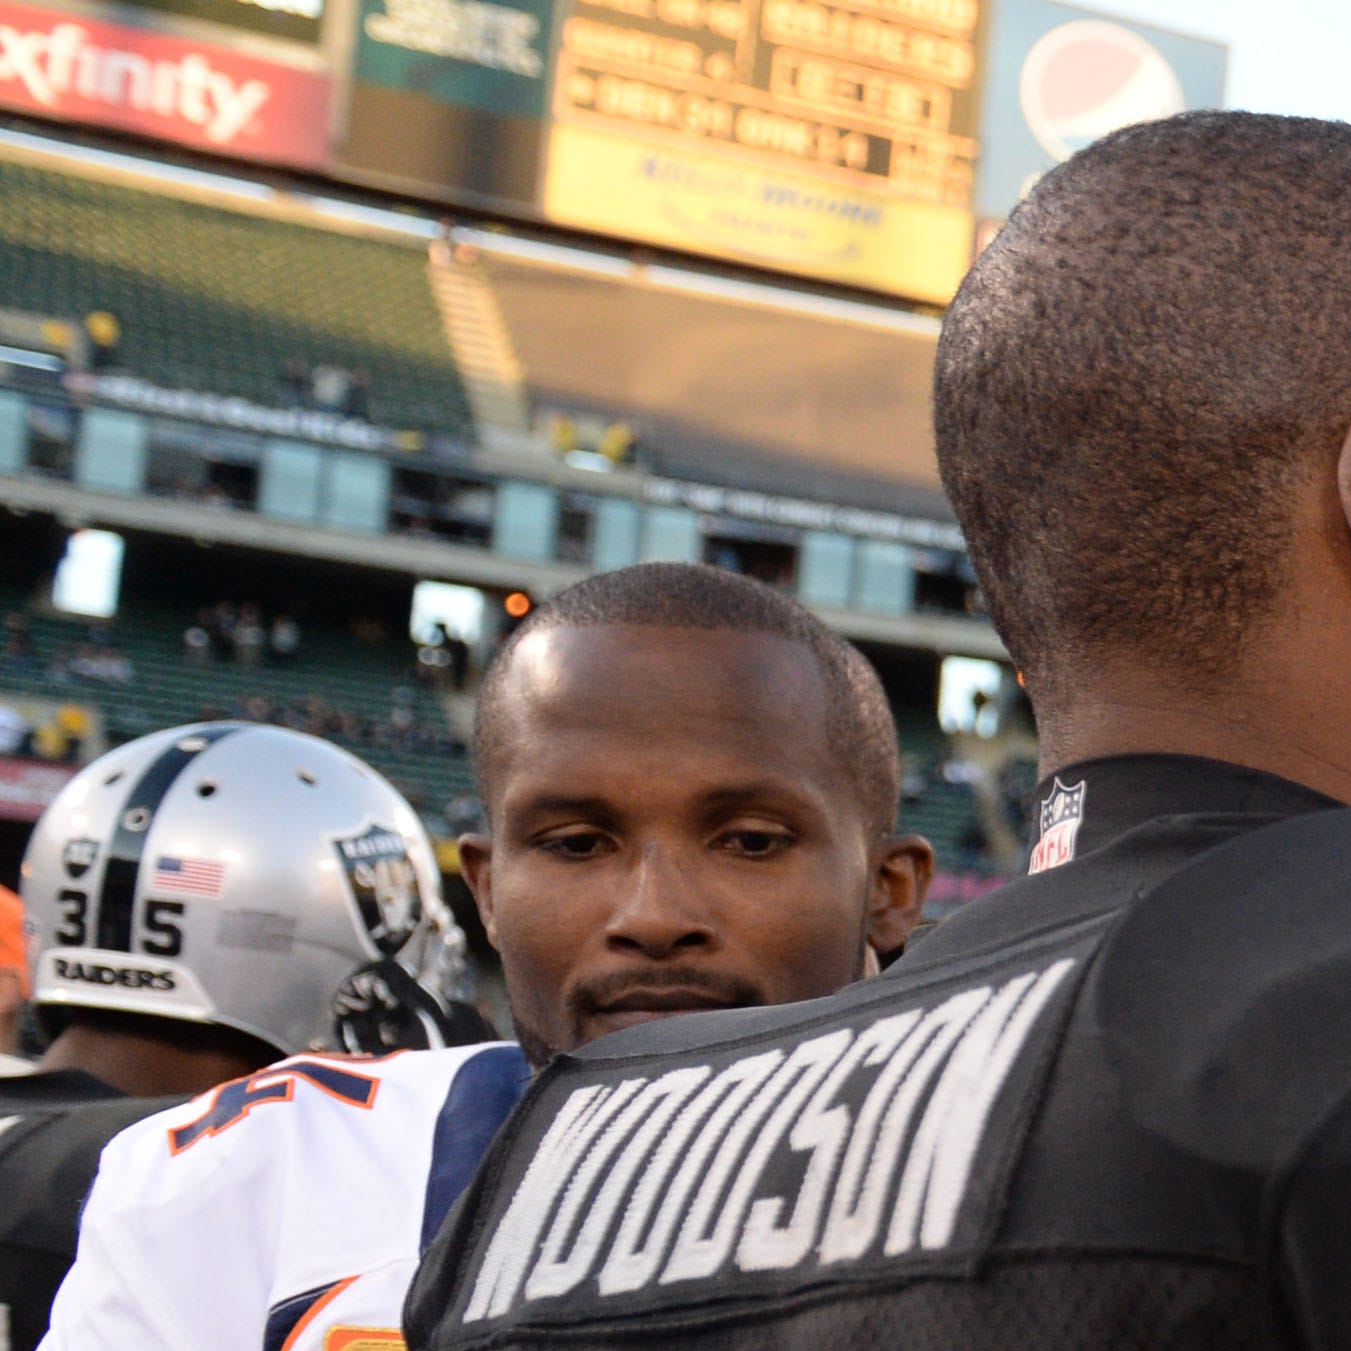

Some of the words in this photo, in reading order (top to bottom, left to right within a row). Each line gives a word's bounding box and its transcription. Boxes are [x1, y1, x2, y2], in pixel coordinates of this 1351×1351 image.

[0, 22, 273, 144] xfinity
[55, 889, 88, 947] 3
[143, 900, 185, 957] 5
[54, 958, 177, 992] RAIDERS
[463, 957, 1077, 1323] WOODSON
